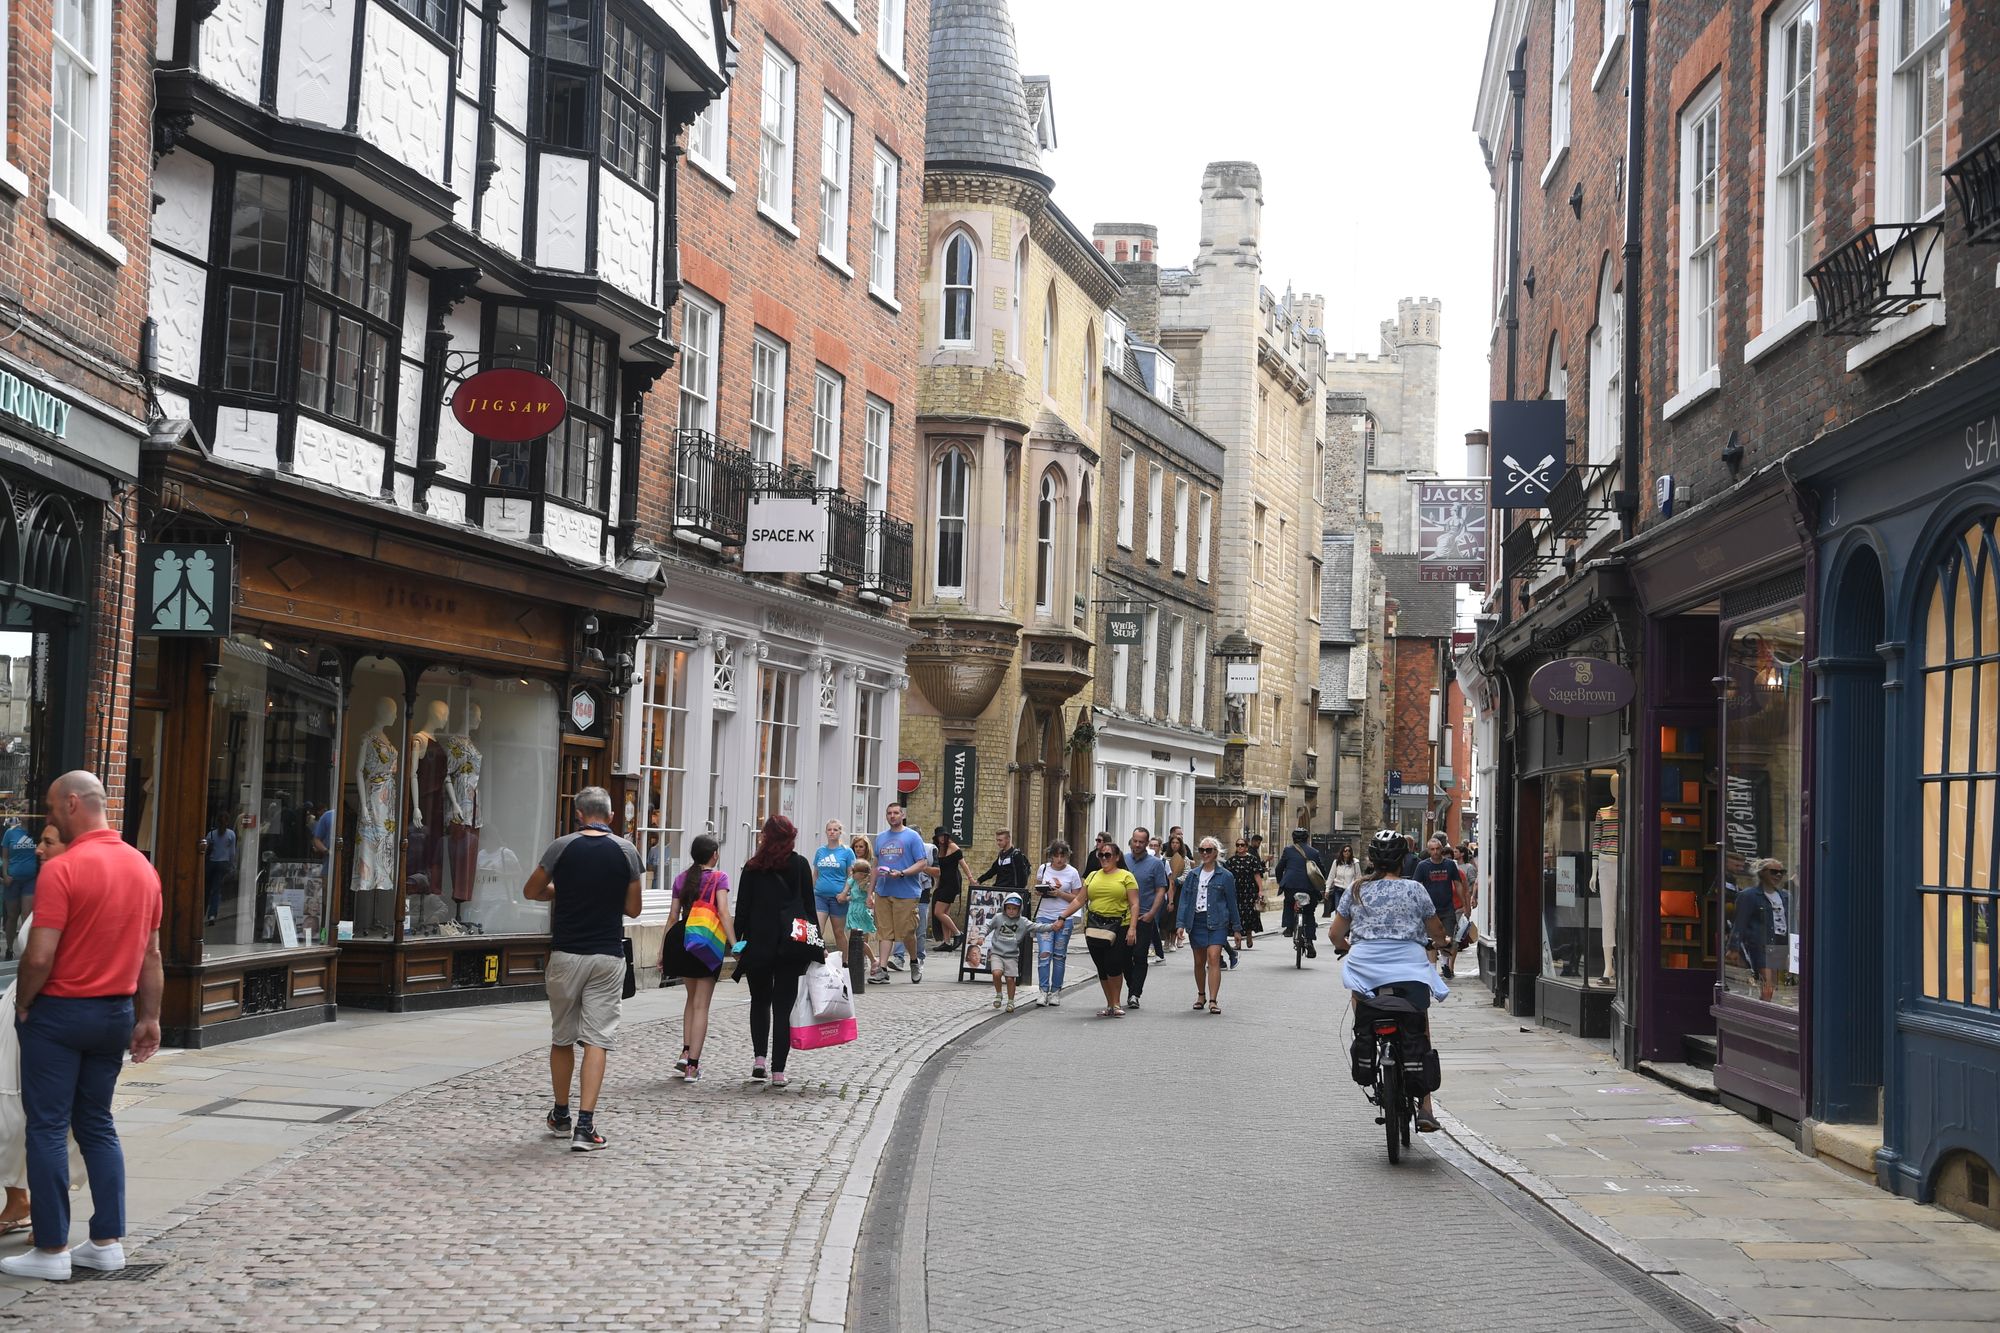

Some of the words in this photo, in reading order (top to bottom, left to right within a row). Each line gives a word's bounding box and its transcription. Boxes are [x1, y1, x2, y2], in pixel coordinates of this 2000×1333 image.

[0, 369, 73, 440] TRINITY
[467, 399, 550, 414] JIGSAW
[1964, 415, 2000, 470] SEA
[1422, 487, 1484, 502] JACKS
[751, 529, 815, 543] SPACE.NK
[1421, 571, 1484, 581] TRINITY
[1548, 687, 1617, 705] SageBrown
[816, 860, 840, 868] adidas
